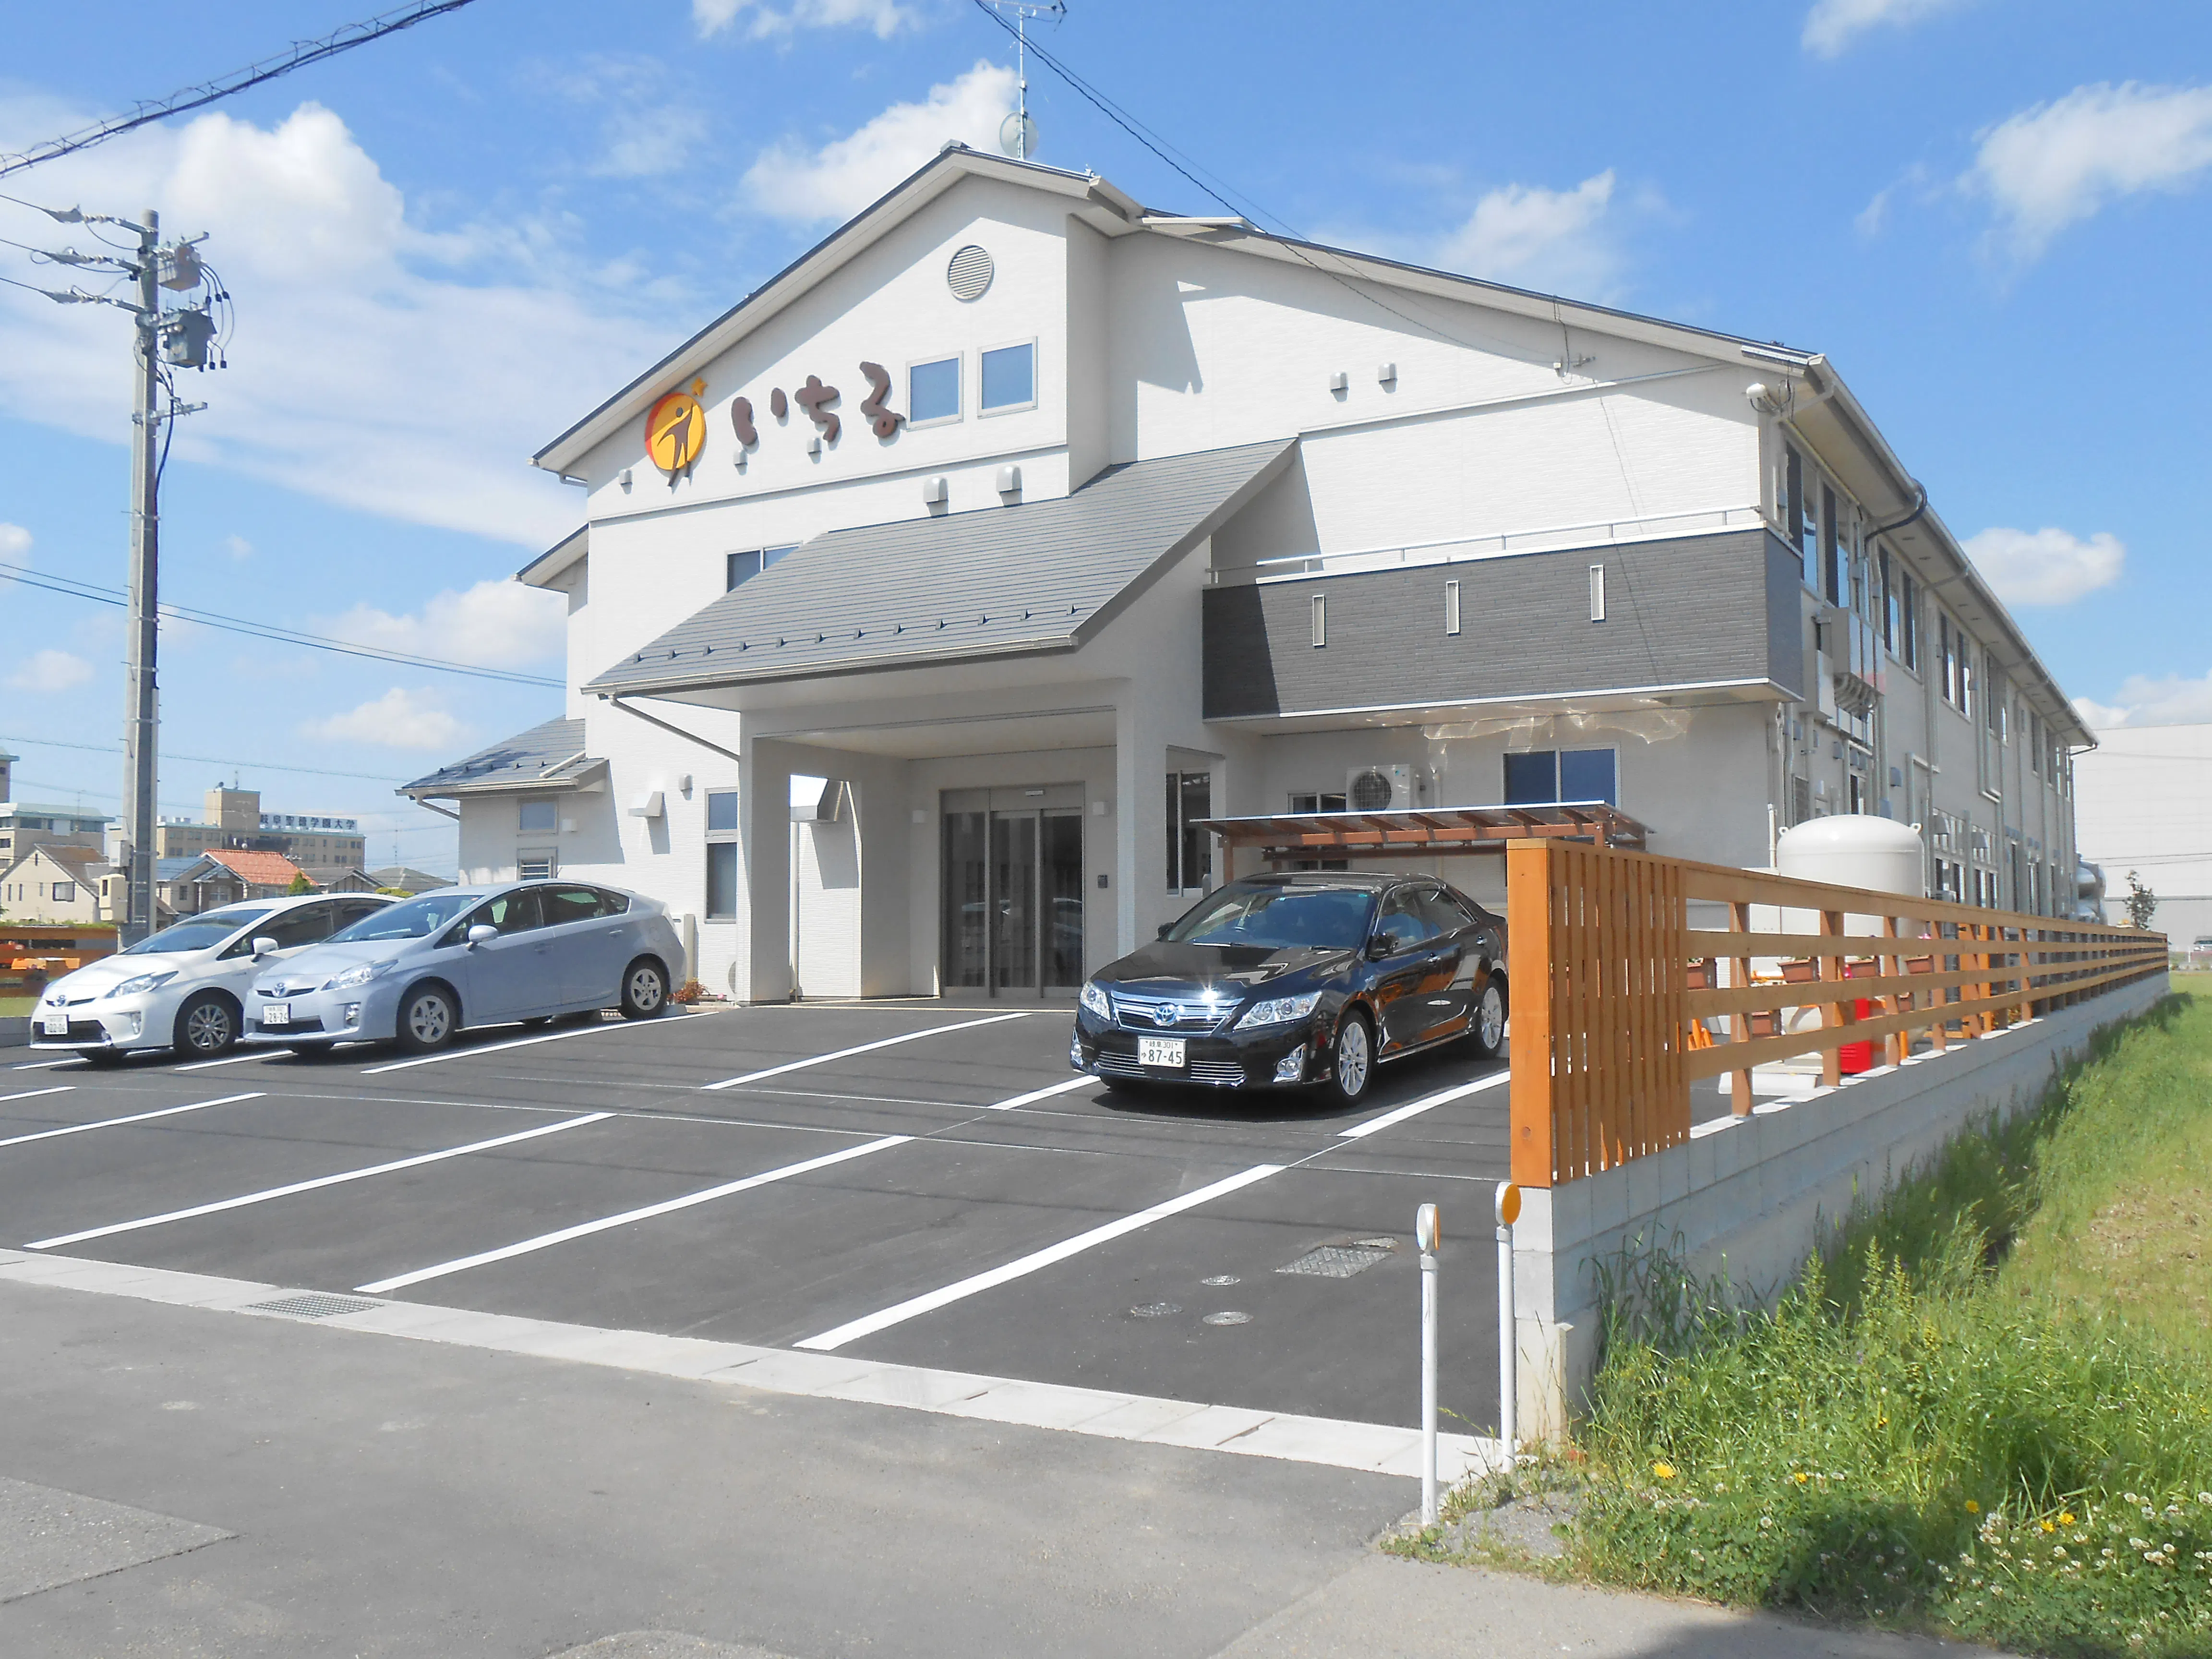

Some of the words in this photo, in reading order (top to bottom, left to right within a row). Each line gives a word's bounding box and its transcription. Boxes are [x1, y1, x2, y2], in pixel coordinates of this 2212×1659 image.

[731, 361, 906, 445] いちる
[1149, 1049, 1182, 1064] 87-45
